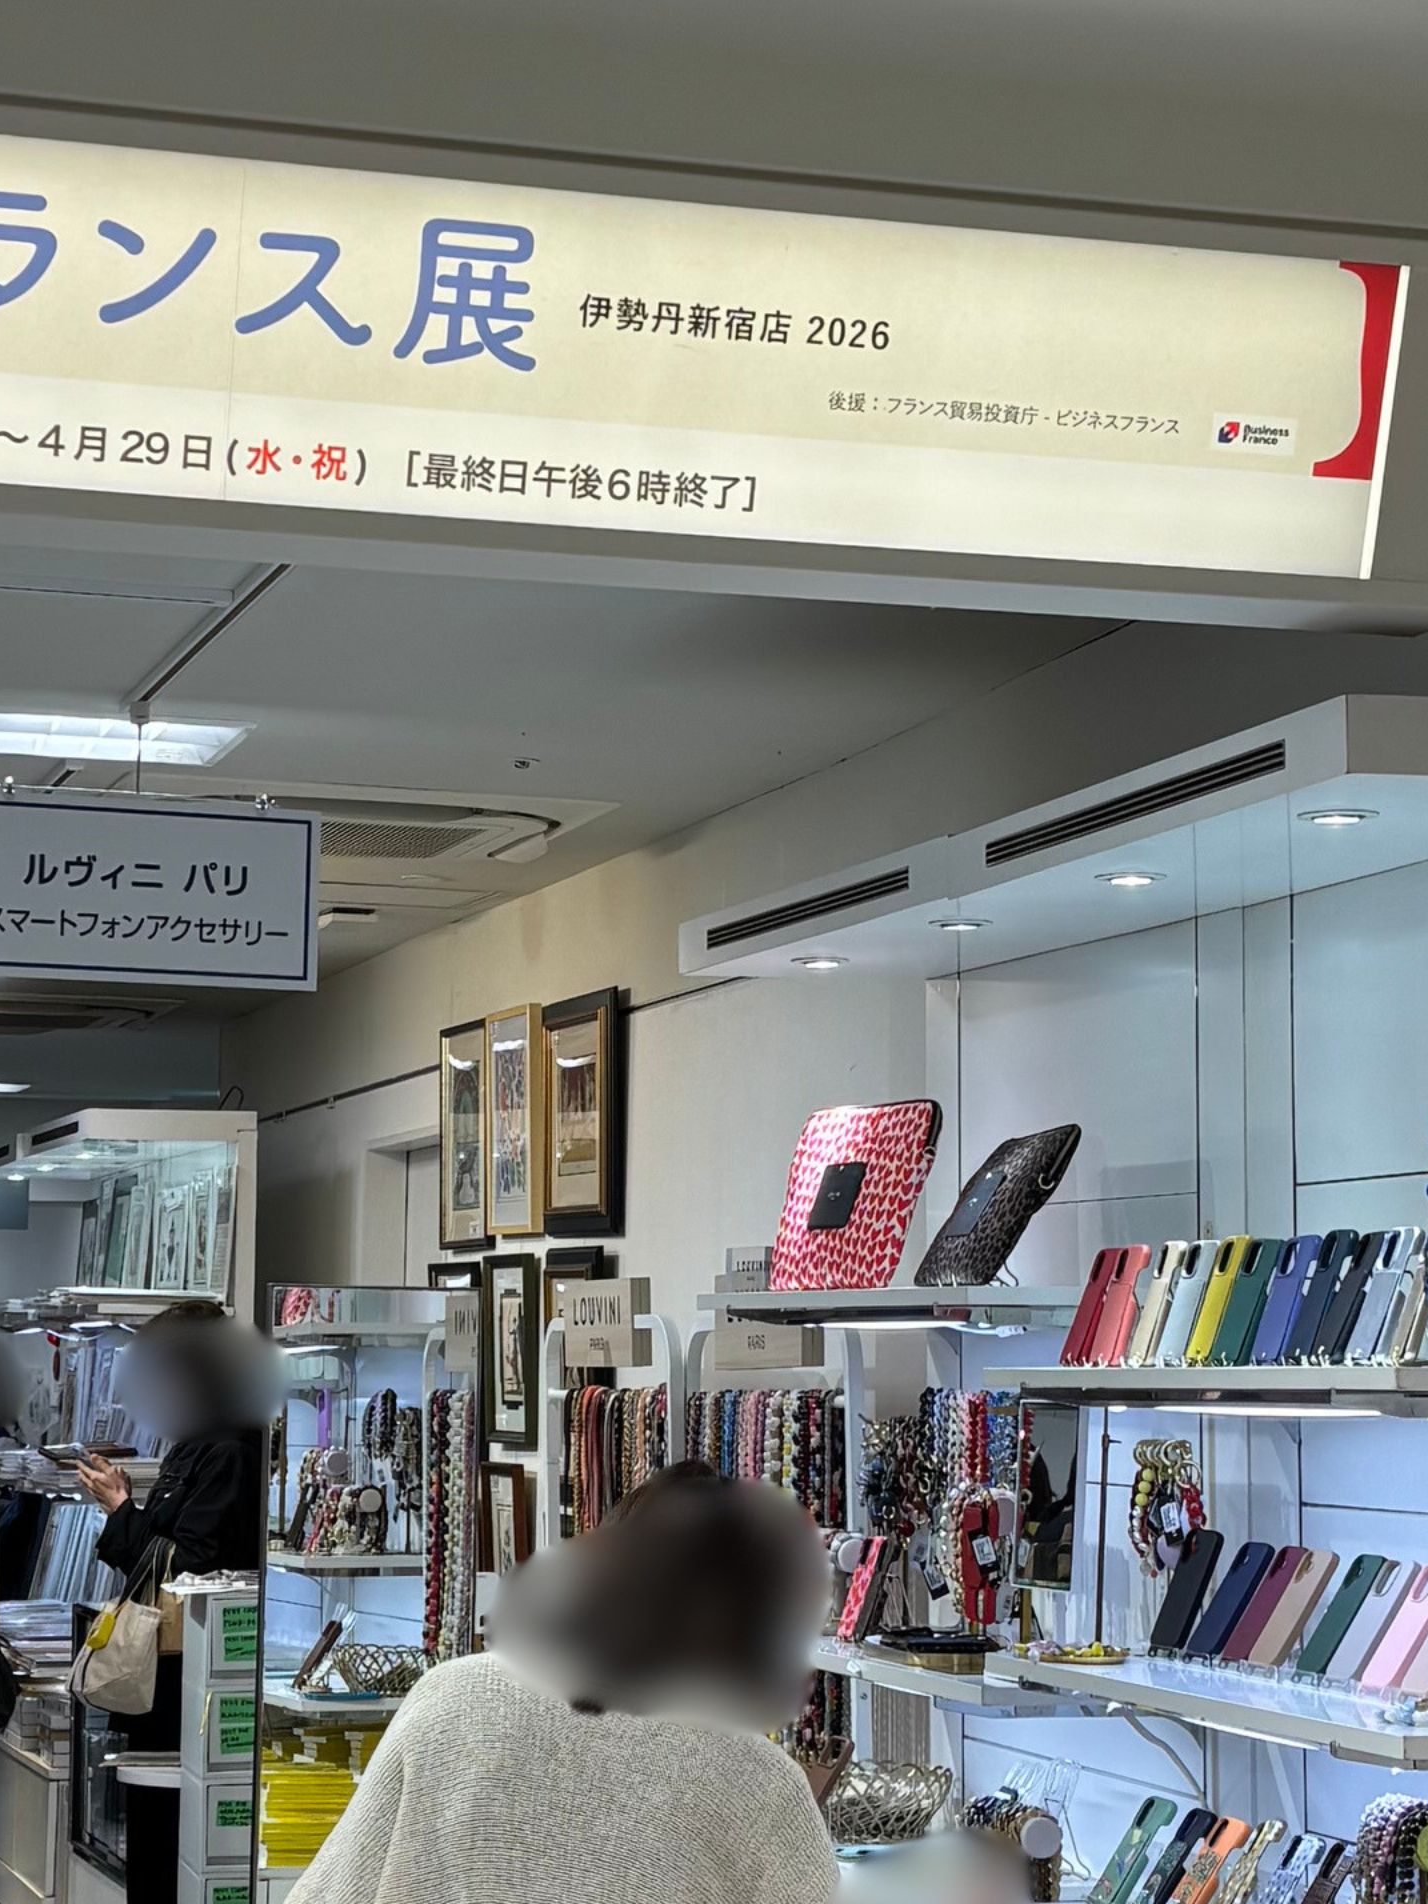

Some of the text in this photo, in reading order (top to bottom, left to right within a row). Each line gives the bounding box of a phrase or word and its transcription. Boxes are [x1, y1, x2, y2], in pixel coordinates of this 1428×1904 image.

[579, 293, 891, 351] 伊勢丹新宿店 2026
[1056, 409, 1181, 435] ビジネスフランス
[23, 853, 249, 898] ルヴィニ パリ
[573, 1296, 621, 1325] LOUVINI
